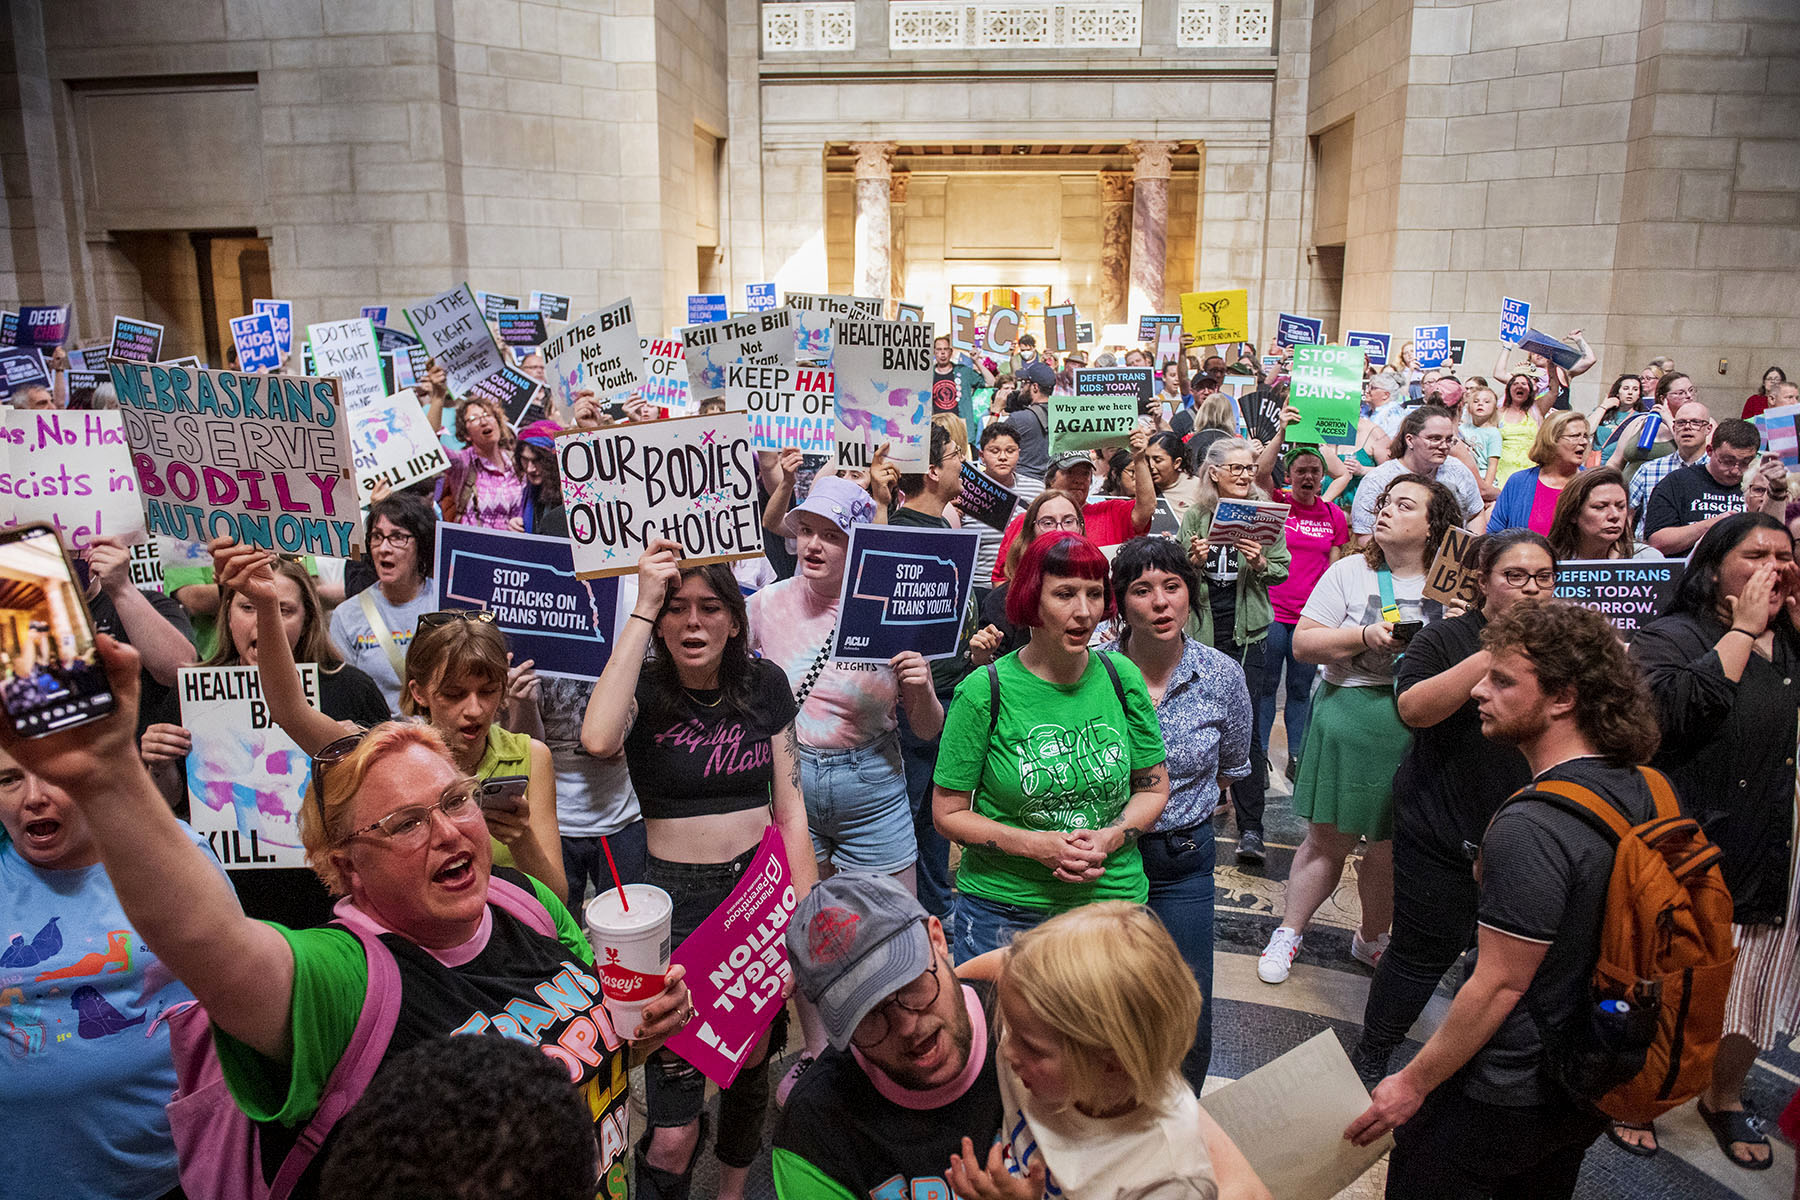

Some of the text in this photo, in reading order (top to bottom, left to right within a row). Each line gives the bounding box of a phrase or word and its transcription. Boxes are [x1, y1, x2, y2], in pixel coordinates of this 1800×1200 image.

[747, 285, 767, 295] LET
[412, 304, 436, 326] DO
[437, 290, 469, 312] THE
[748, 295, 775, 306] KIDS
[785, 296, 812, 310] Kill
[818, 298, 848, 313] The
[853, 301, 881, 317] Bill
[1504, 300, 1522, 312] LET
[234, 318, 259, 335] LET
[1503, 311, 1526, 326] KIDS
[316, 322, 368, 344] DO THE
[432, 314, 472, 347] RIGHT
[543, 335, 564, 364] Kill
[566, 324, 596, 347] The
[599, 304, 632, 332] Bill
[684, 311, 790, 348] Kill The Bill
[838, 322, 932, 348] HEALTHCARE
[1416, 328, 1439, 339] LET
[1501, 322, 1526, 337] PLAY
[237, 330, 273, 349] KIDS
[741, 341, 763, 356] Not
[1416, 340, 1446, 350] KIDS
[241, 343, 275, 362] PLAY
[325, 343, 369, 366] RIGHT
[435, 337, 473, 362] THING
[580, 343, 602, 362] Not
[1299, 348, 1348, 363] STOP
[1416, 350, 1447, 361] PLAY
[587, 356, 622, 377] Trans
[651, 359, 677, 376] OF
[882, 348, 931, 371] BANS
[501, 367, 531, 390] TRANS
[597, 368, 638, 391] Youth.
[728, 366, 789, 389] KEEP
[1080, 373, 1146, 383] DEFEND TRANS
[1297, 365, 1334, 377] THE
[490, 374, 517, 396] ODAY,
[1080, 382, 1140, 392] KIDS: TODAY,
[1296, 383, 1352, 400] BANS.
[110, 363, 337, 428] NEBRASKANS
[747, 391, 795, 413] OUT
[1055, 404, 1077, 414] Why
[1113, 402, 1132, 410] here
[36, 414, 78, 449] No
[1054, 416, 1134, 433] AGAIN??
[1316, 420, 1347, 428] ABORTION
[1321, 427, 1346, 435] ACCESS
[121, 408, 340, 473] DESERVE
[407, 448, 445, 478] Kill
[562, 435, 751, 508] OUR BODIES
[109, 468, 134, 492] in
[133, 453, 341, 517] BODILY
[977, 477, 1008, 501] TRANS
[963, 477, 996, 505] TODAY,
[1703, 492, 1726, 501] Ban
[1231, 511, 1276, 523] Freedom
[1300, 519, 1321, 527] SPEAK
[148, 499, 356, 558] AUTONOMY
[570, 500, 763, 560] OUR CHOICE!
[1227, 530, 1264, 540] Choose
[1301, 525, 1311, 533] NO
[895, 564, 924, 580] STOP
[1206, 560, 1217, 568] ME
[493, 568, 529, 587] STOP
[1615, 569, 1671, 581] TRANS
[491, 587, 577, 611] ATTACKS ON
[893, 582, 949, 598] ATTACKS ON
[1552, 585, 1658, 600] KIDS: TODAY,
[892, 599, 952, 615] TRANS YOUTH.
[491, 605, 589, 630] TRANS YOUTH.
[844, 636, 869, 647] ACLU
[836, 661, 878, 672] RIGHTS
[654, 718, 746, 753] Alpha
[1054, 715, 1108, 757] LOVE
[704, 742, 772, 778] Male
[1021, 741, 1127, 799] QUEER
[723, 876, 770, 929] Parenthood
[743, 883, 775, 922] Planned
[599, 968, 643, 993] Casey's
